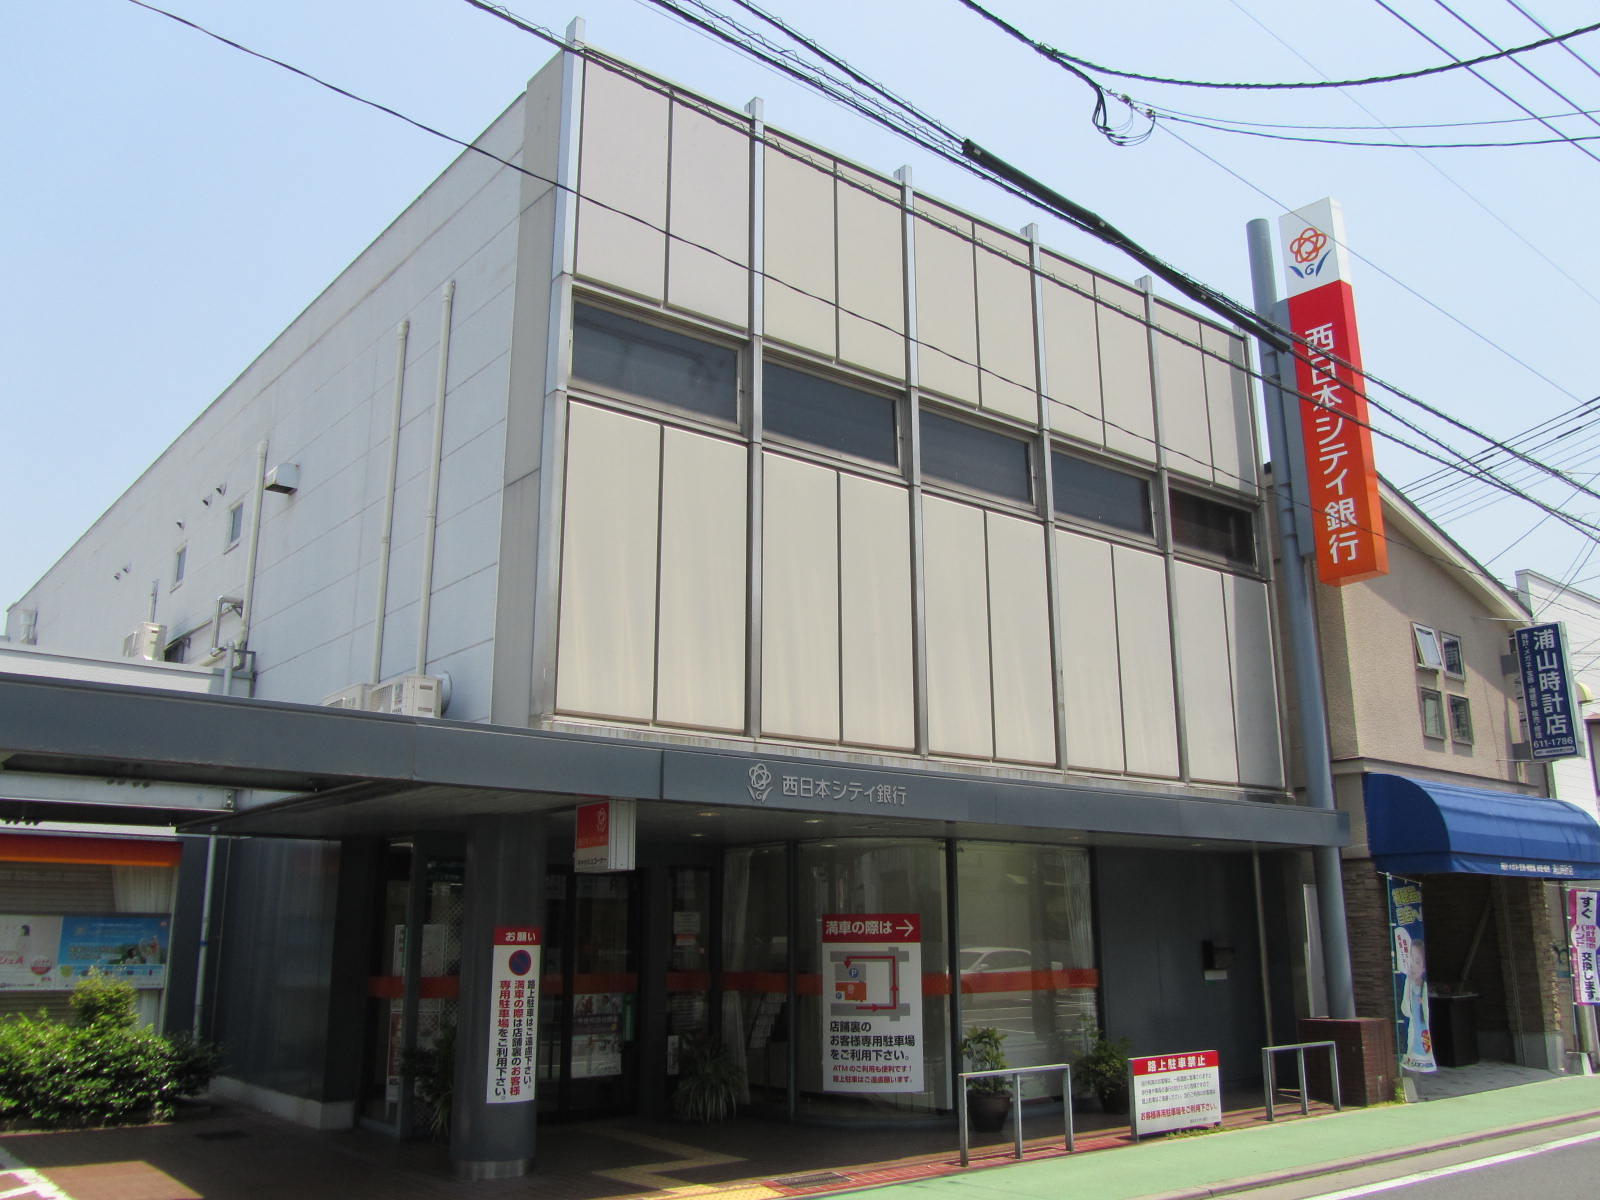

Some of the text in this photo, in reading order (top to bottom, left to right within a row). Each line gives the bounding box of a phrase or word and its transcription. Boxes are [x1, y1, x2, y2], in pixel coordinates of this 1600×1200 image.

[1305, 322, 1359, 564] 西日本シティ銀行
[1533, 629, 1568, 735] 浦山時計店
[782, 775, 907, 806] 西日本シティ銀行
[1579, 896, 1593, 919] すぐ
[505, 930, 537, 942] お願い
[825, 920, 893, 935] 満車の際は
[829, 1021, 872, 1033] 店舗裏の
[494, 979, 512, 1099] 専用駐車場をご利用下さい。
[509, 979, 525, 1096] 満車の際は店舗裏のお客様
[829, 1035, 916, 1047] お客様専用駐車場
[830, 1049, 910, 1061] をご利用下さい。
[1147, 1055, 1206, 1072] 路上駐車禁止
